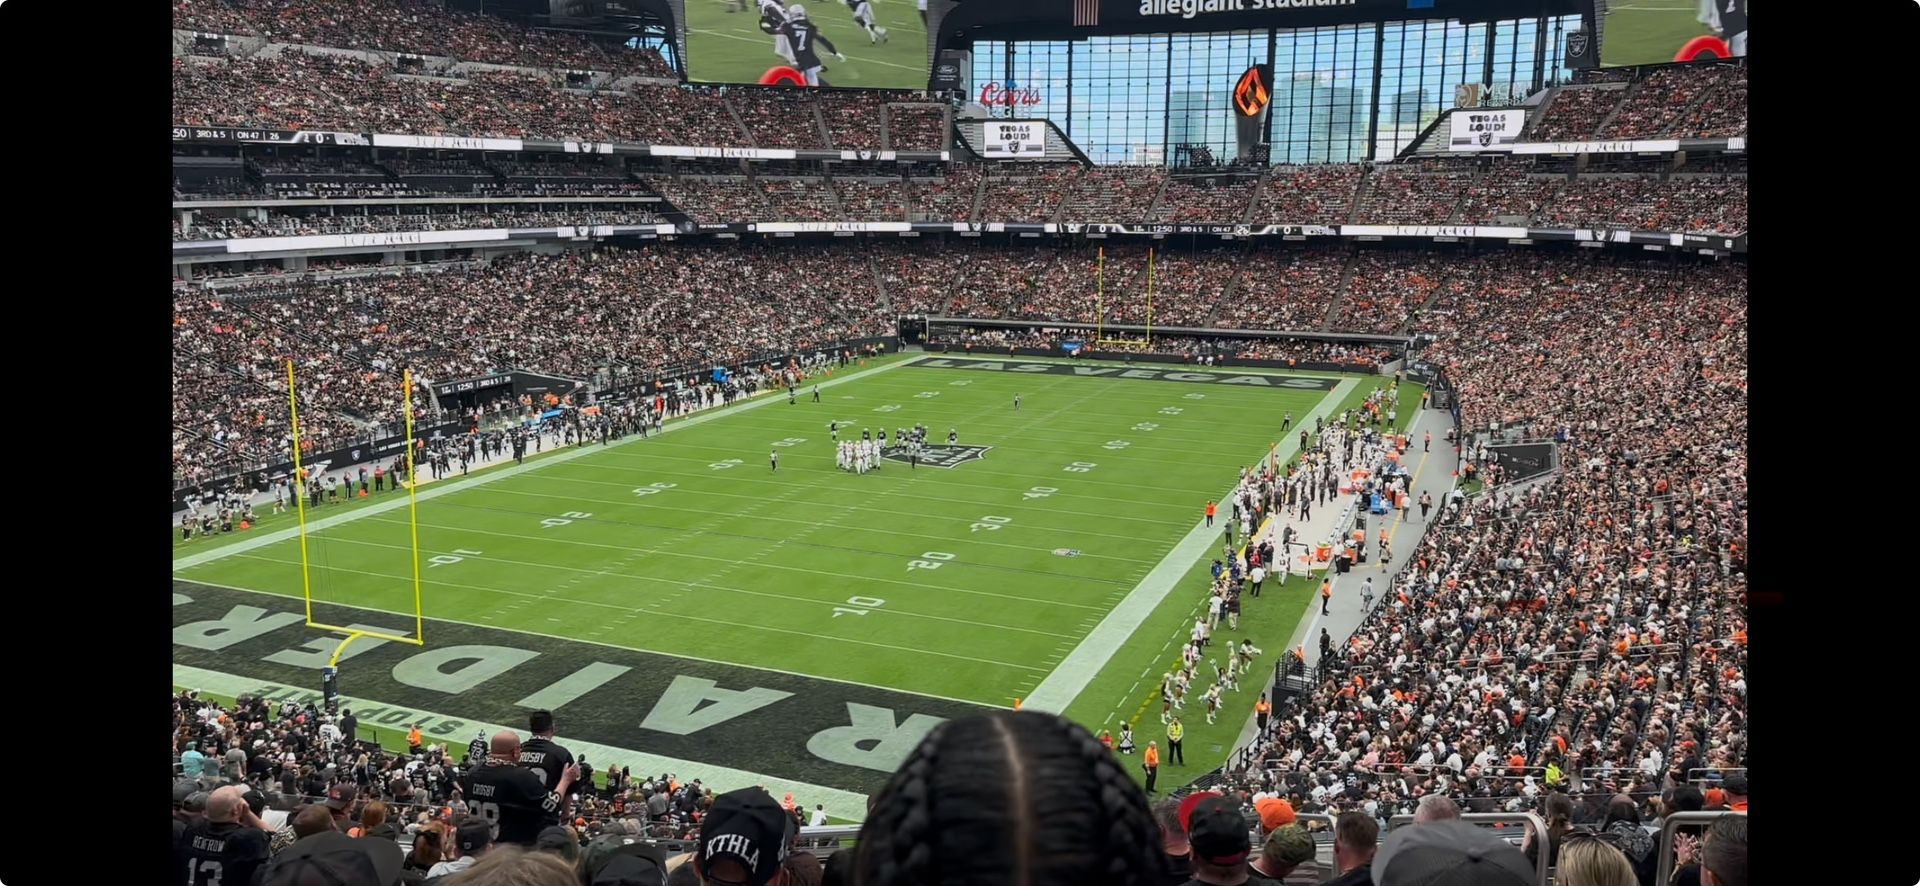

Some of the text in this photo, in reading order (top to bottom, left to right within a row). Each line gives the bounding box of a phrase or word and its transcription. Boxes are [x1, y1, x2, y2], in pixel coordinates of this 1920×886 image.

[795, 29, 808, 51] 7
[980, 82, 1042, 106] Coors
[1469, 124, 1506, 132] LOUD!
[927, 359, 1326, 388] LAS VEGAS
[457, 382, 473, 391] 12:50
[1063, 461, 1097, 473] 50
[1023, 486, 1059, 498] 40
[542, 511, 592, 527] 20
[971, 515, 1012, 531] 30
[430, 549, 482, 566] 10
[909, 551, 956, 570] 20
[833, 596, 886, 615] 10
[355, 706, 465, 735] STOP
[519, 751, 547, 764] ROSBY
[472, 783, 496, 797] CROSBY
[192, 835, 226, 853] RENFROW
[705, 834, 760, 874] KTHLA
[188, 857, 224, 886] 13
